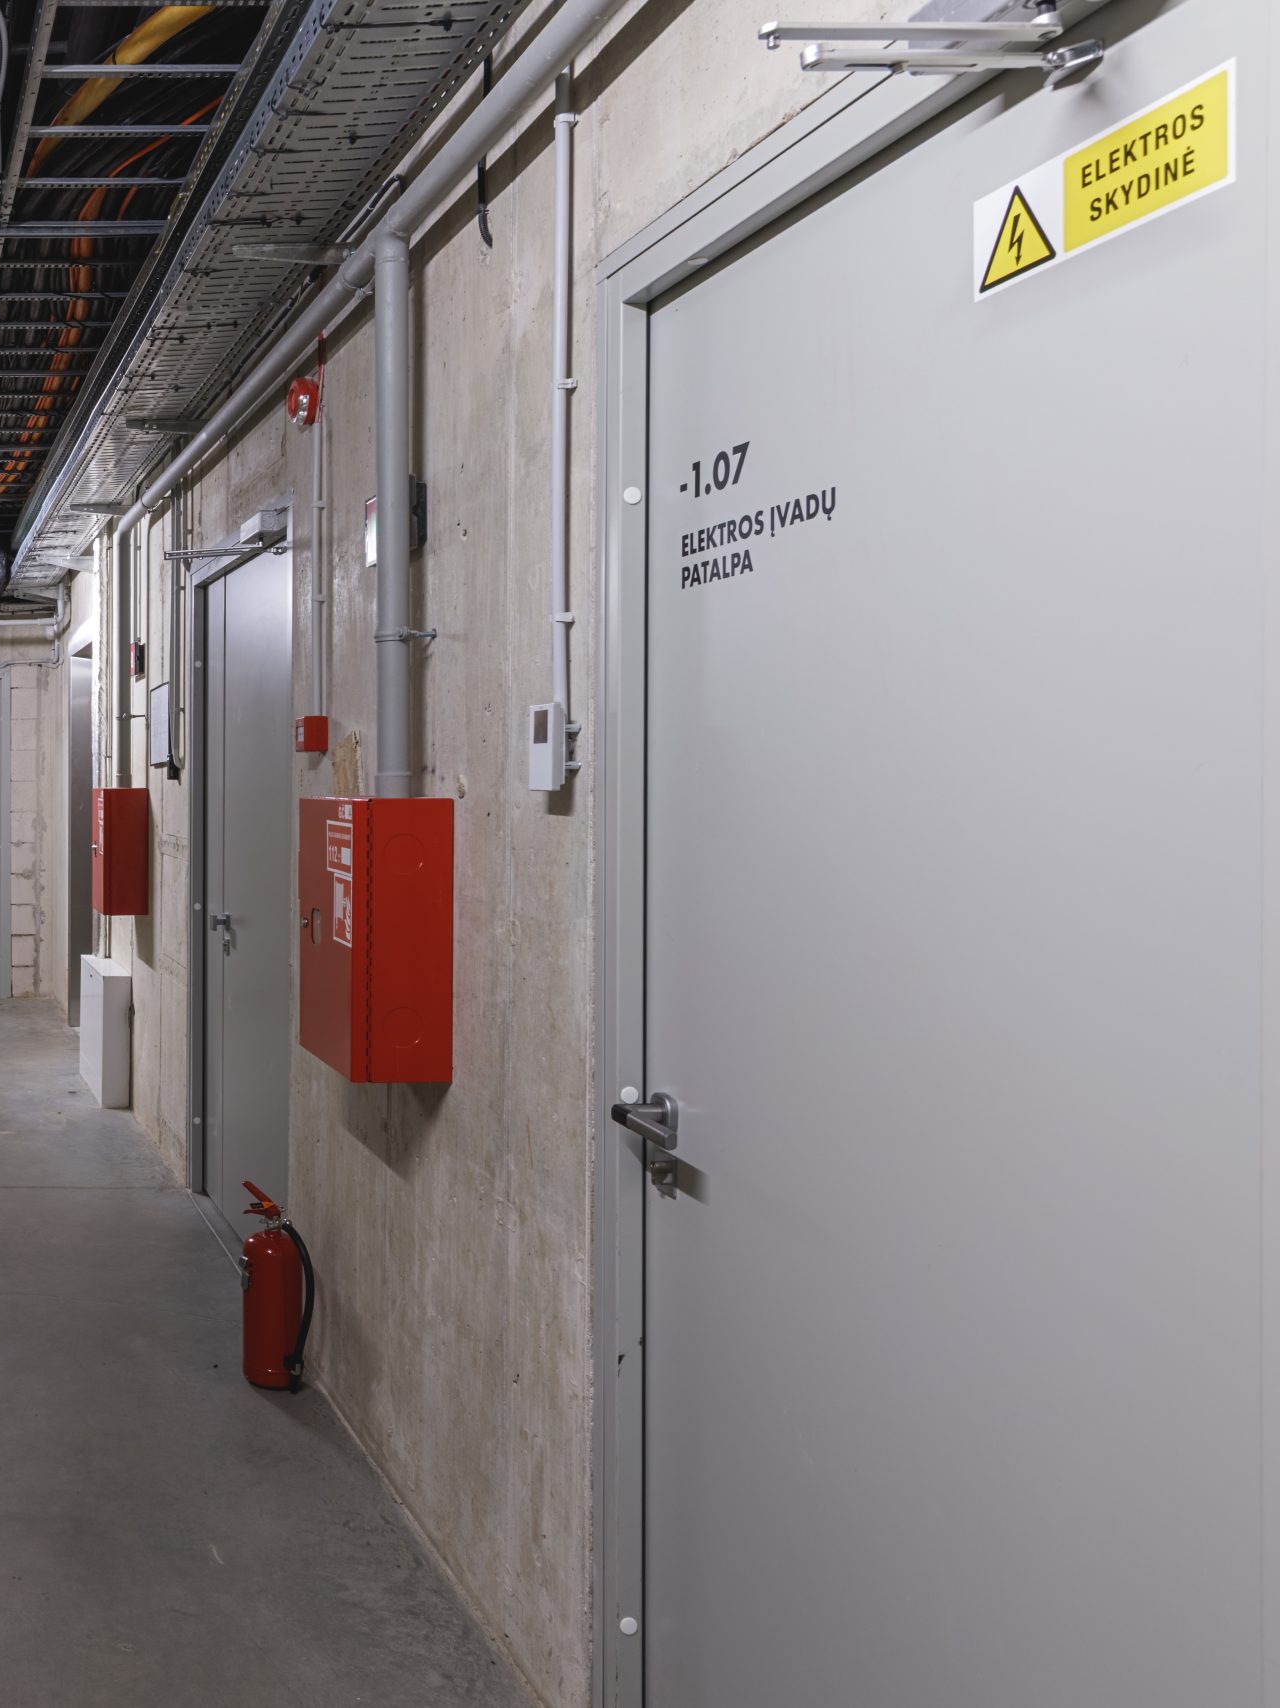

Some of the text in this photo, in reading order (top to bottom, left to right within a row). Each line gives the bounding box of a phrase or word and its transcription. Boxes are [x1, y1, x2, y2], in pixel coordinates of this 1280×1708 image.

[1080, 103, 1206, 189] ELEKTROS
[1089, 145, 1197, 223] SKYDINĖ
[679, 440, 751, 499] -1.07
[680, 486, 837, 558] ELEKTROS ĮVADŲ
[680, 549, 755, 590] PATALPA
